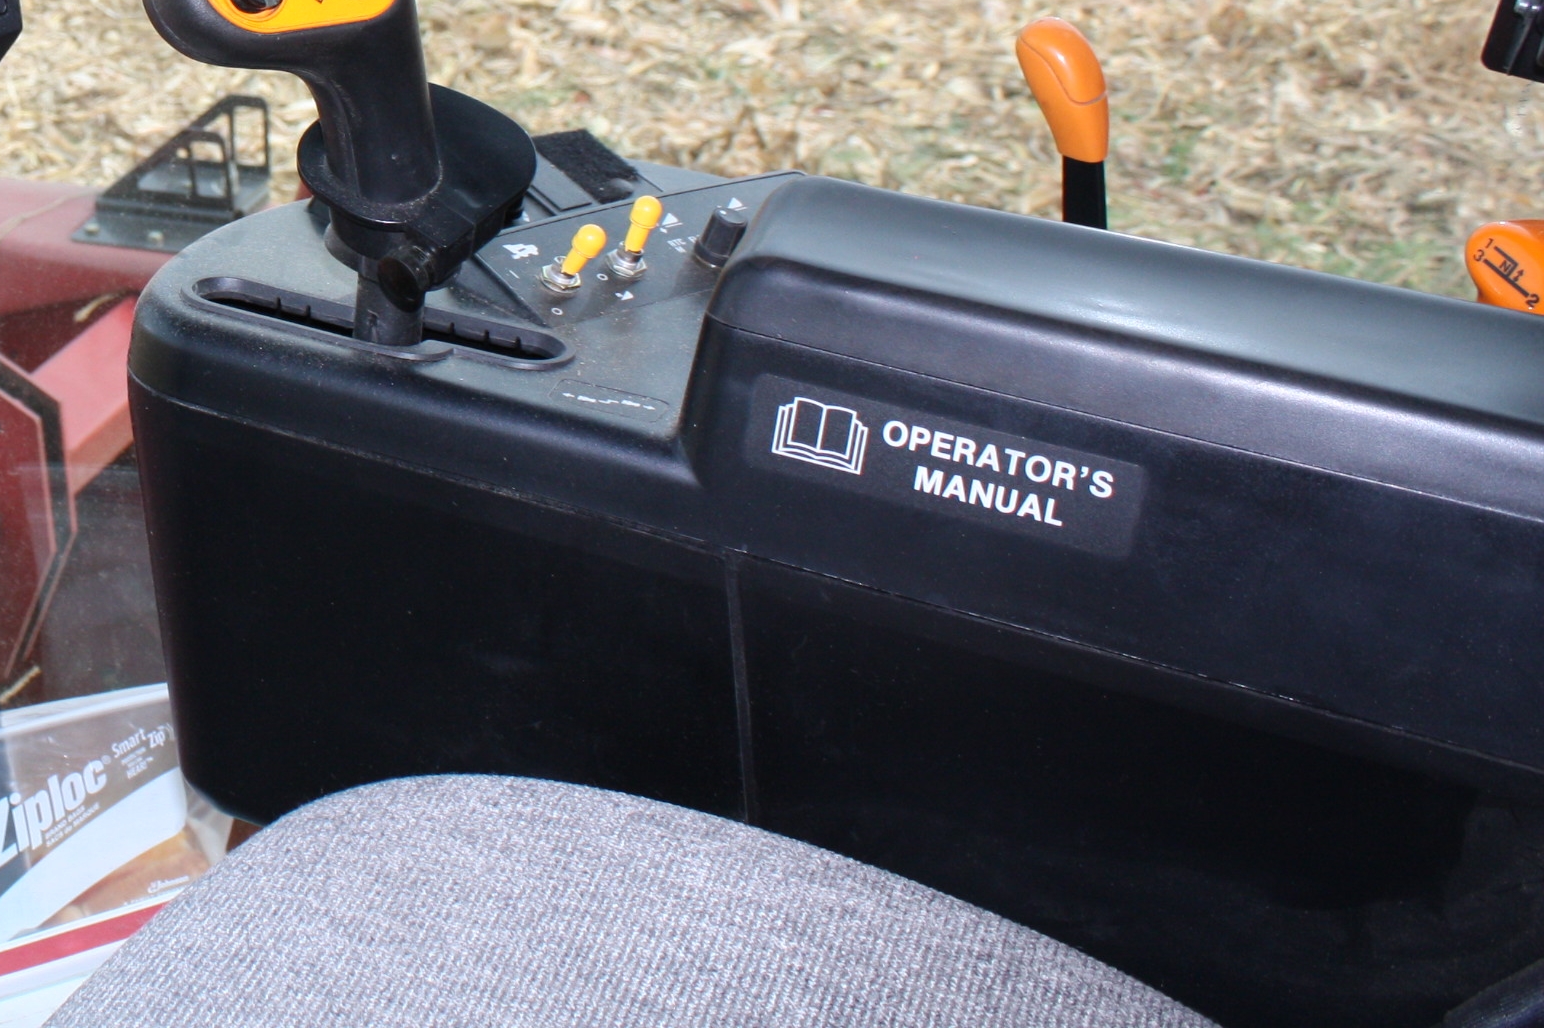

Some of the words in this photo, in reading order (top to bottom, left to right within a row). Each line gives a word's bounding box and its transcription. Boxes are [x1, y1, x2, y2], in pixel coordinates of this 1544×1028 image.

[1485, 238, 1495, 249] 1
[1473, 249, 1485, 262] 3
[1499, 259, 1512, 273] N
[1525, 293, 1540, 308] 2
[882, 419, 1116, 499] OPERATOR'S
[913, 465, 1064, 527] MANUAL
[111, 727, 147, 759] Smart
[147, 729, 166, 749] Zip
